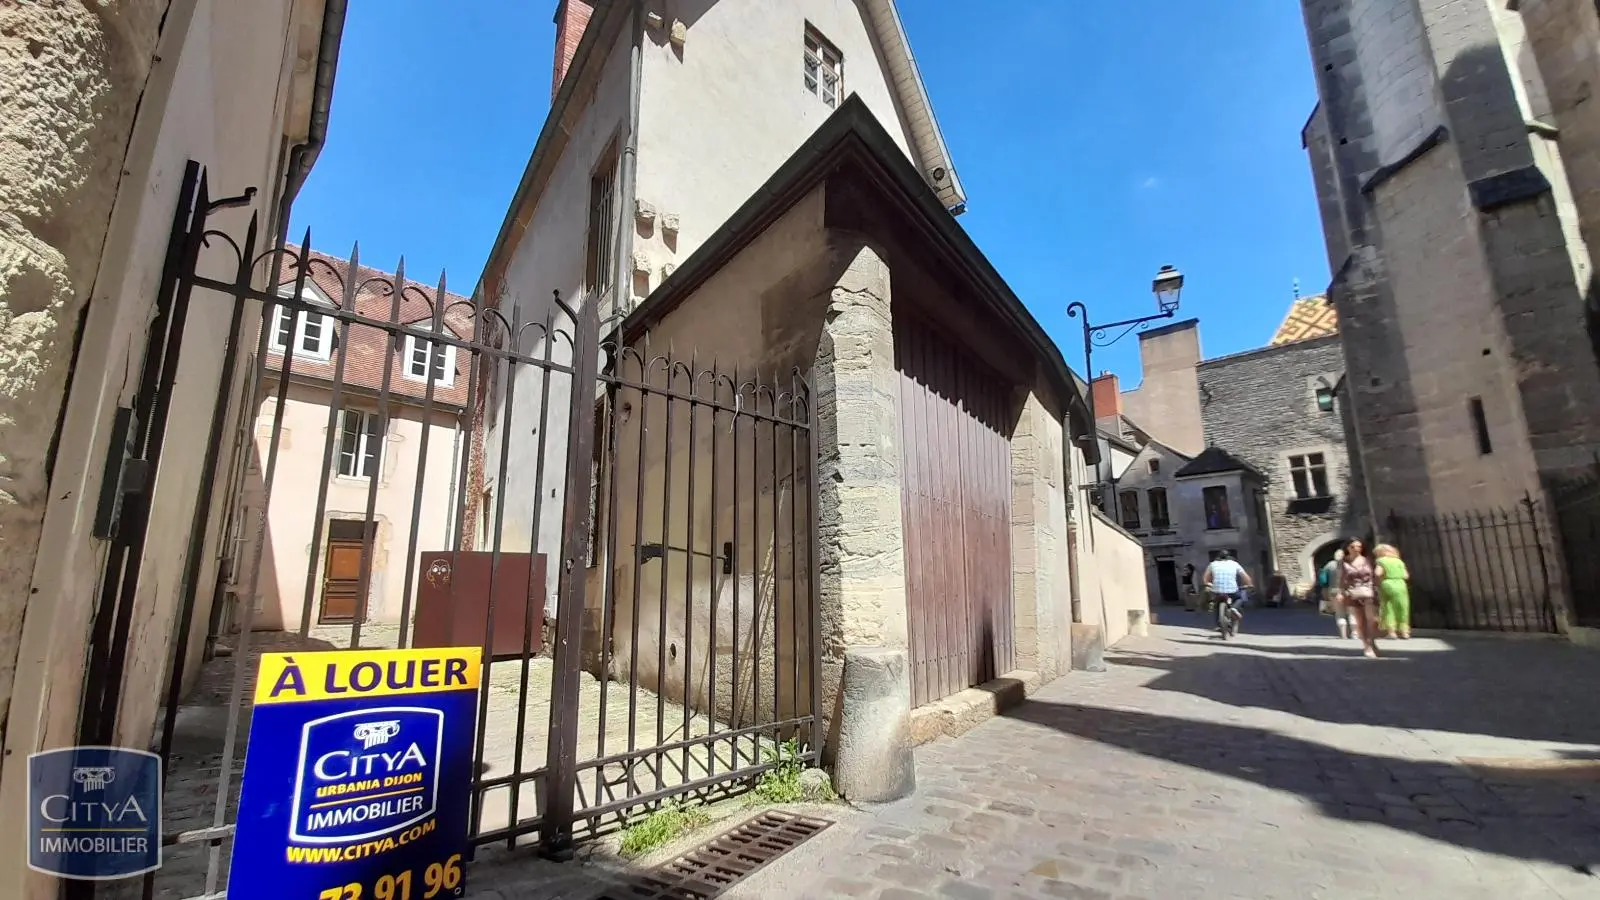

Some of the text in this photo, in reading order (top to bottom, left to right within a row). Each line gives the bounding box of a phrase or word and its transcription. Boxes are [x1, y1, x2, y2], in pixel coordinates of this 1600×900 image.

[269, 656, 468, 697] À LOUER
[316, 772, 423, 798] URBANIA DIJON
[307, 796, 423, 831] IMMOBILIER
[286, 818, 436, 863] WWW.CITYA.COM
[424, 854, 461, 899] 96
